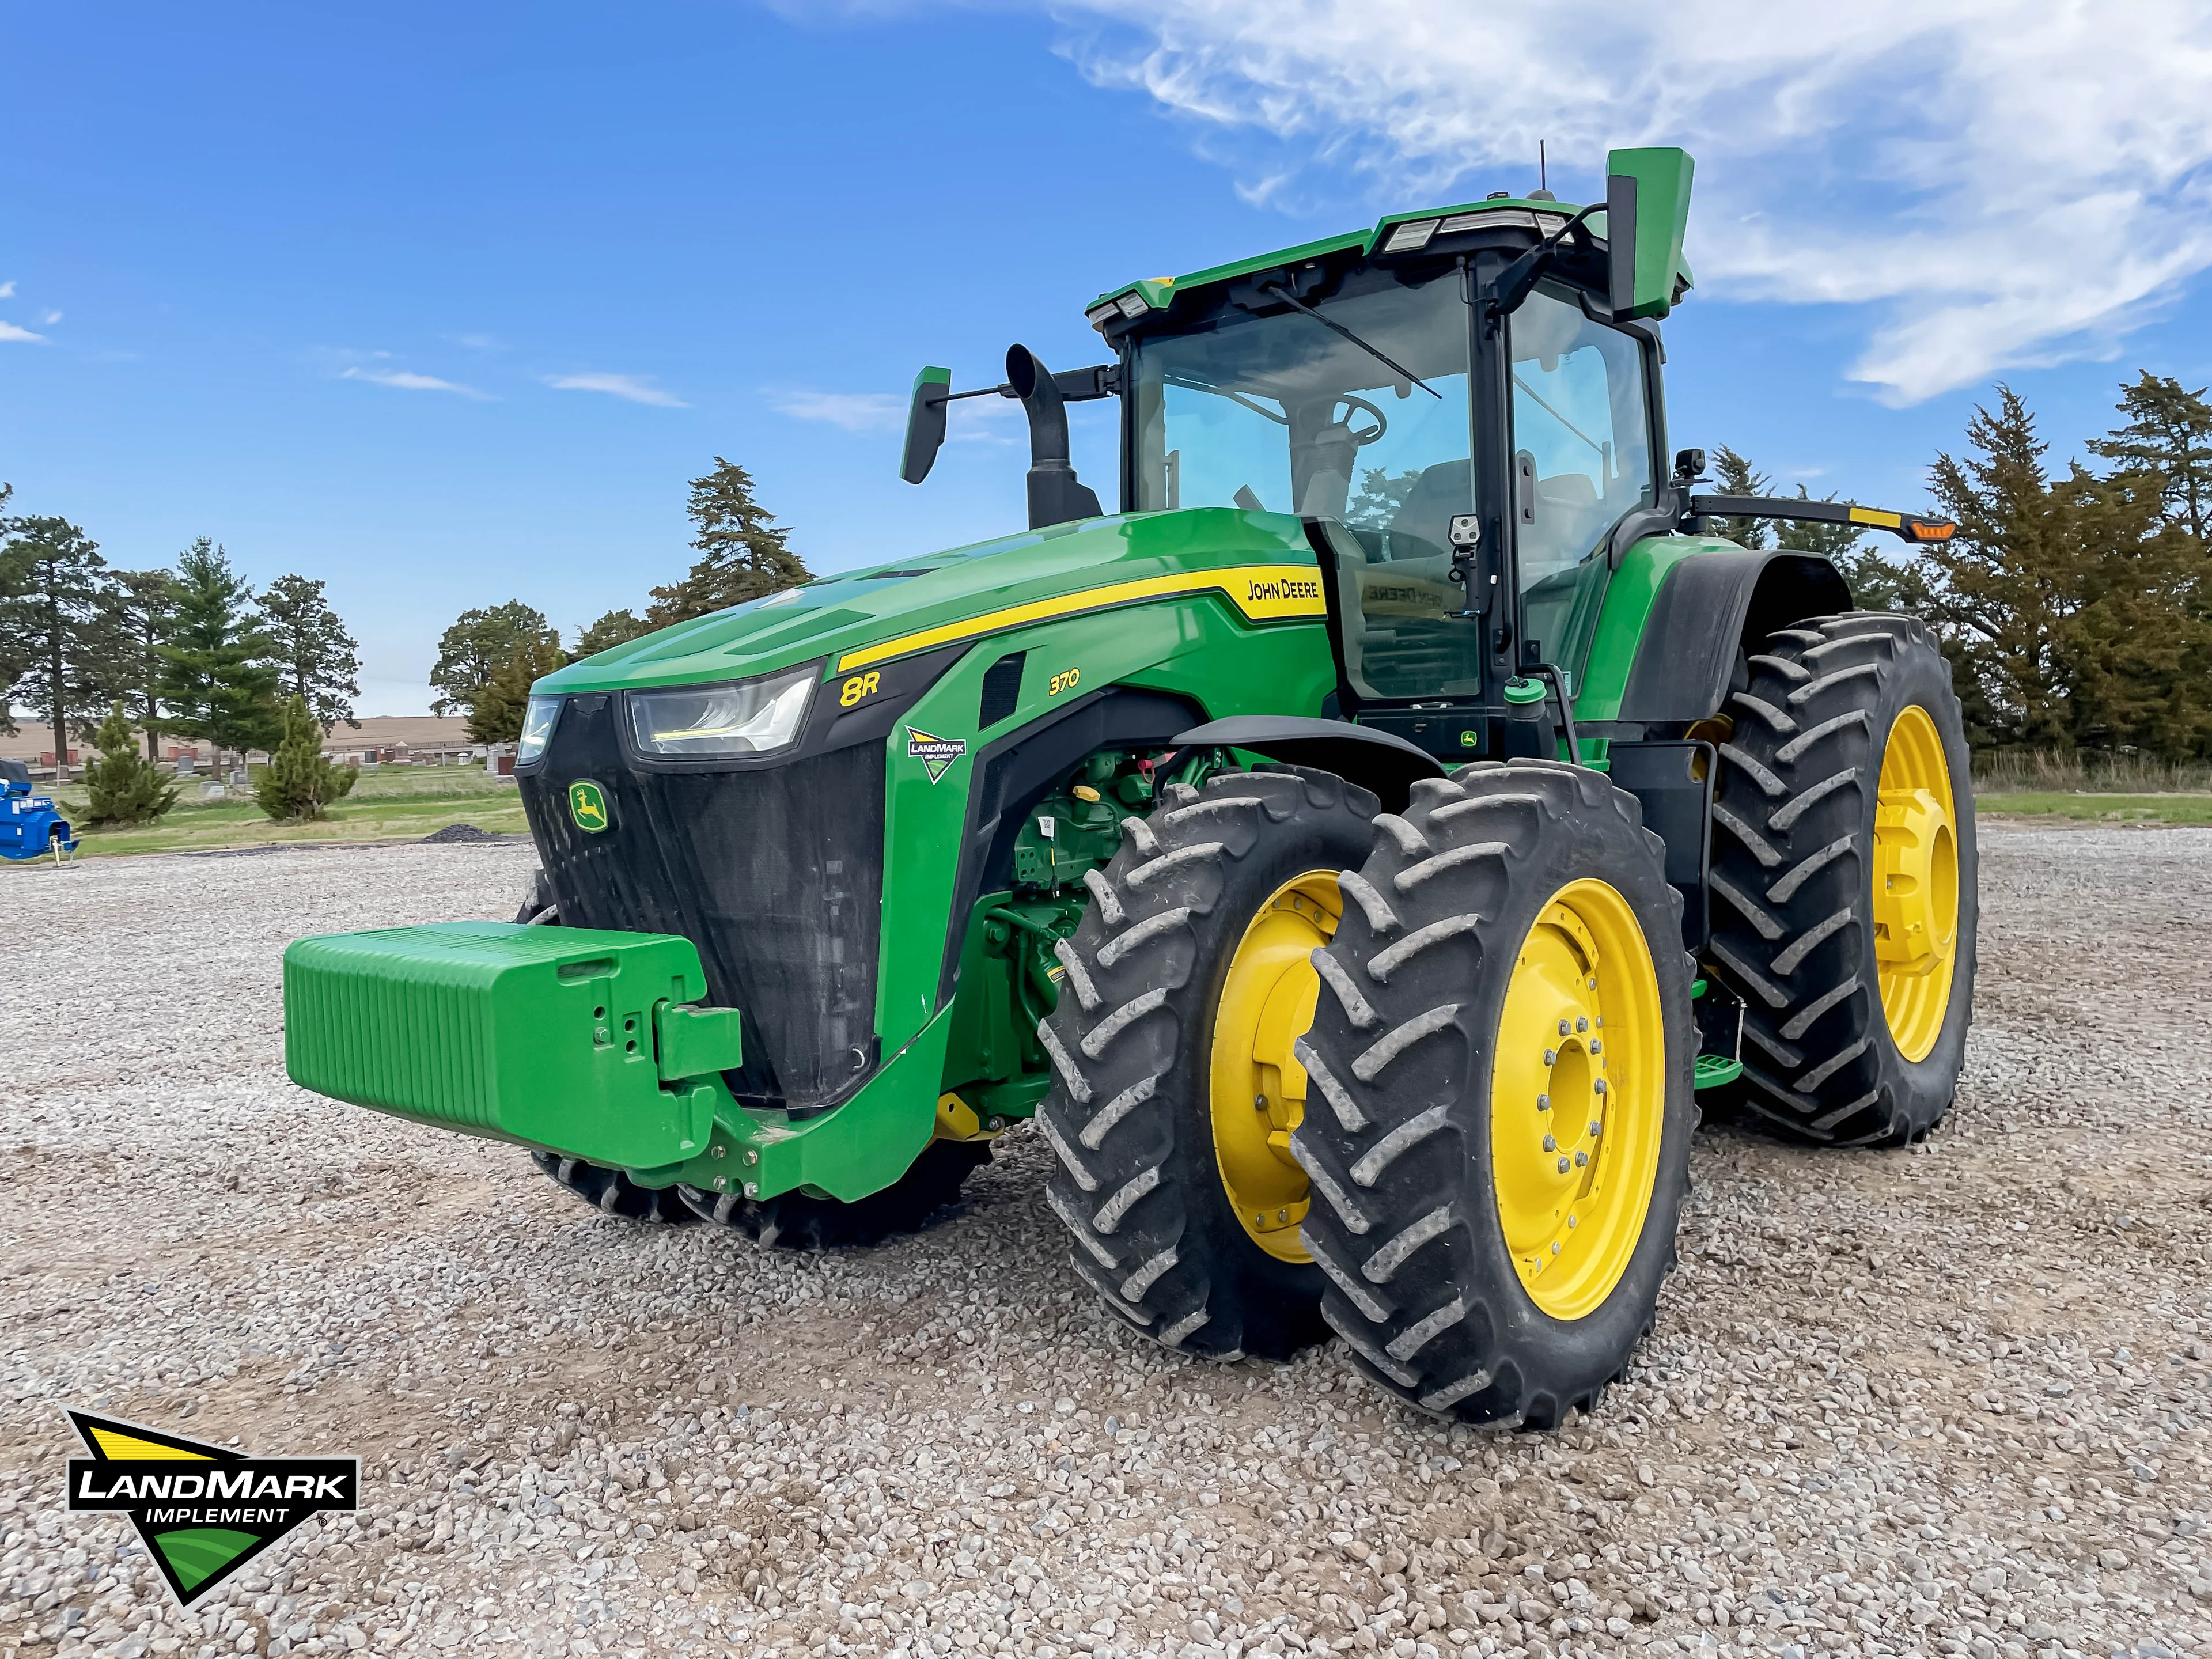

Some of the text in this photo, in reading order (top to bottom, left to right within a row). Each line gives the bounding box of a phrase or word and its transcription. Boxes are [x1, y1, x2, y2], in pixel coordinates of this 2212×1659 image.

[1248, 579, 1319, 601] JOHN DEERE
[840, 671, 880, 707] 8R
[1049, 667, 1080, 696] 370
[911, 744, 964, 753] LANDMARK
